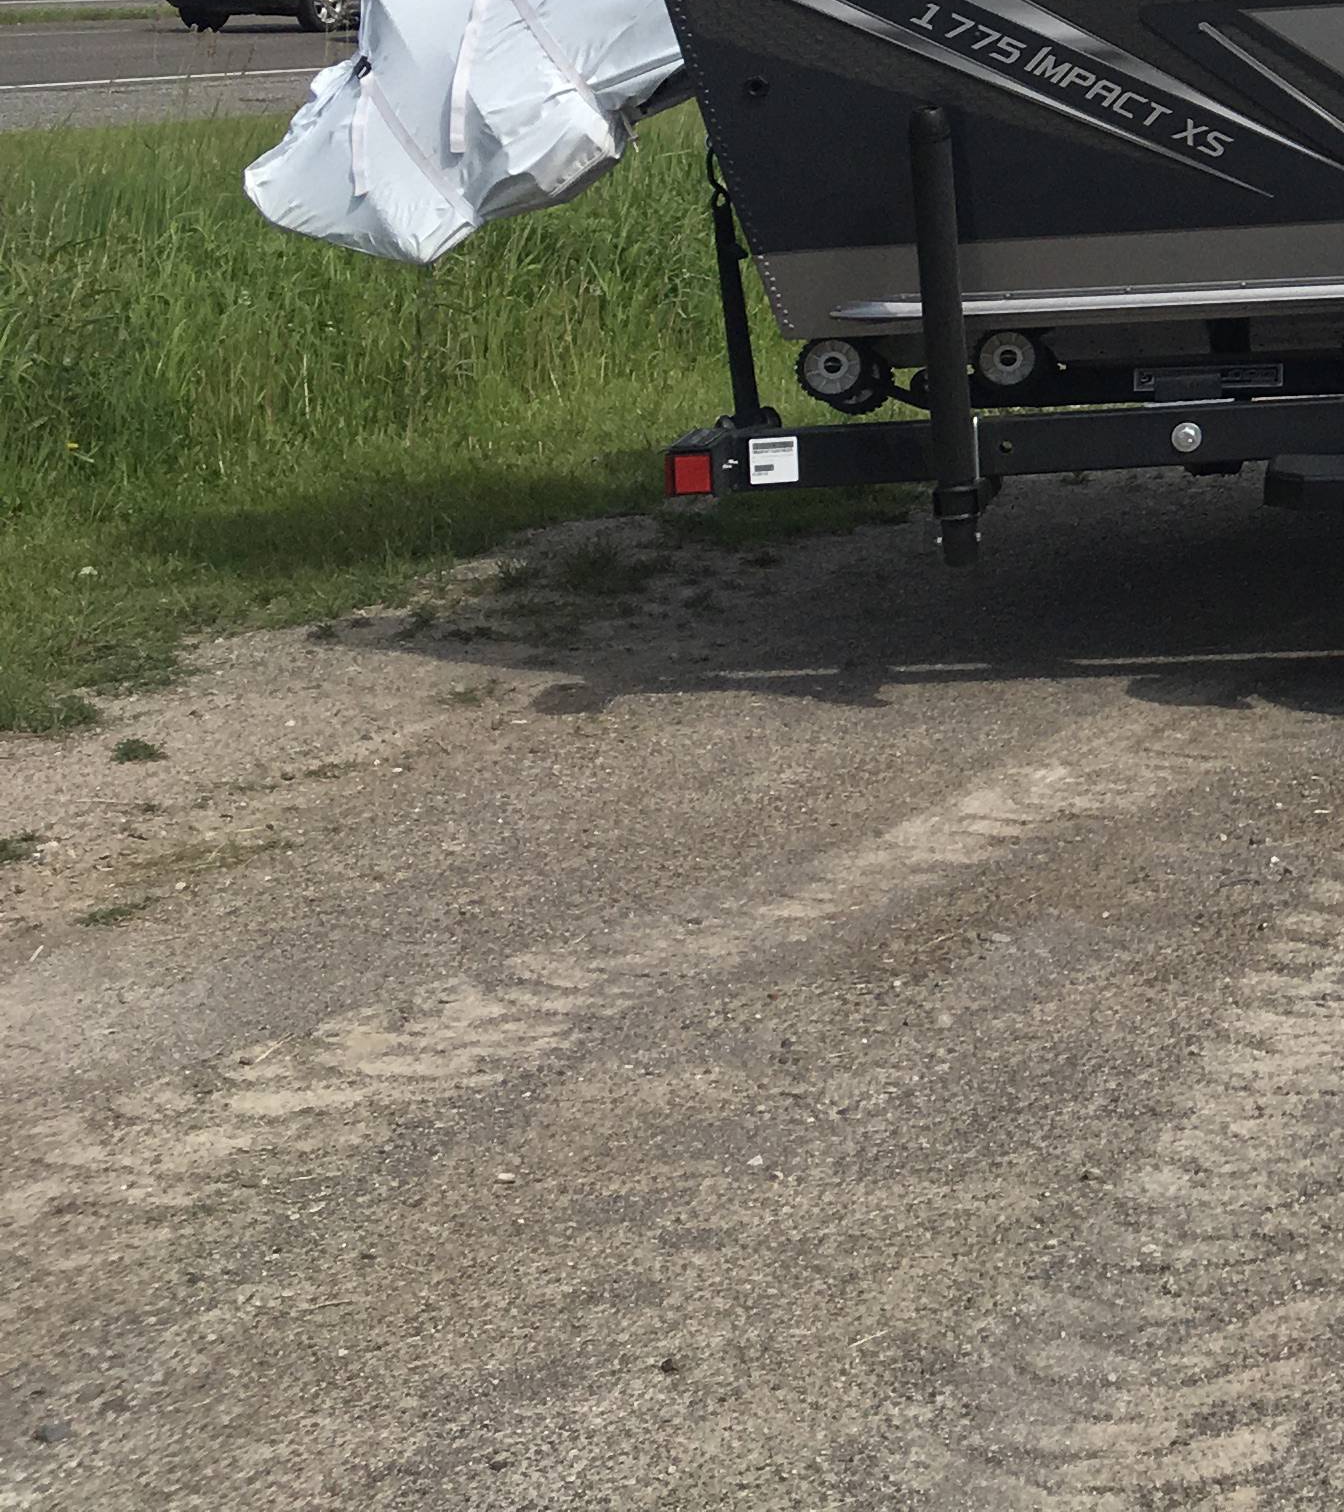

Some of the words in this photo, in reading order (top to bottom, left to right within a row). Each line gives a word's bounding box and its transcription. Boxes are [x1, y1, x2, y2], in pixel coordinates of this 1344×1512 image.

[909, 2, 1027, 65] 1775
[1023, 46, 1173, 127] IMPACT
[1170, 118, 1235, 158] XS
